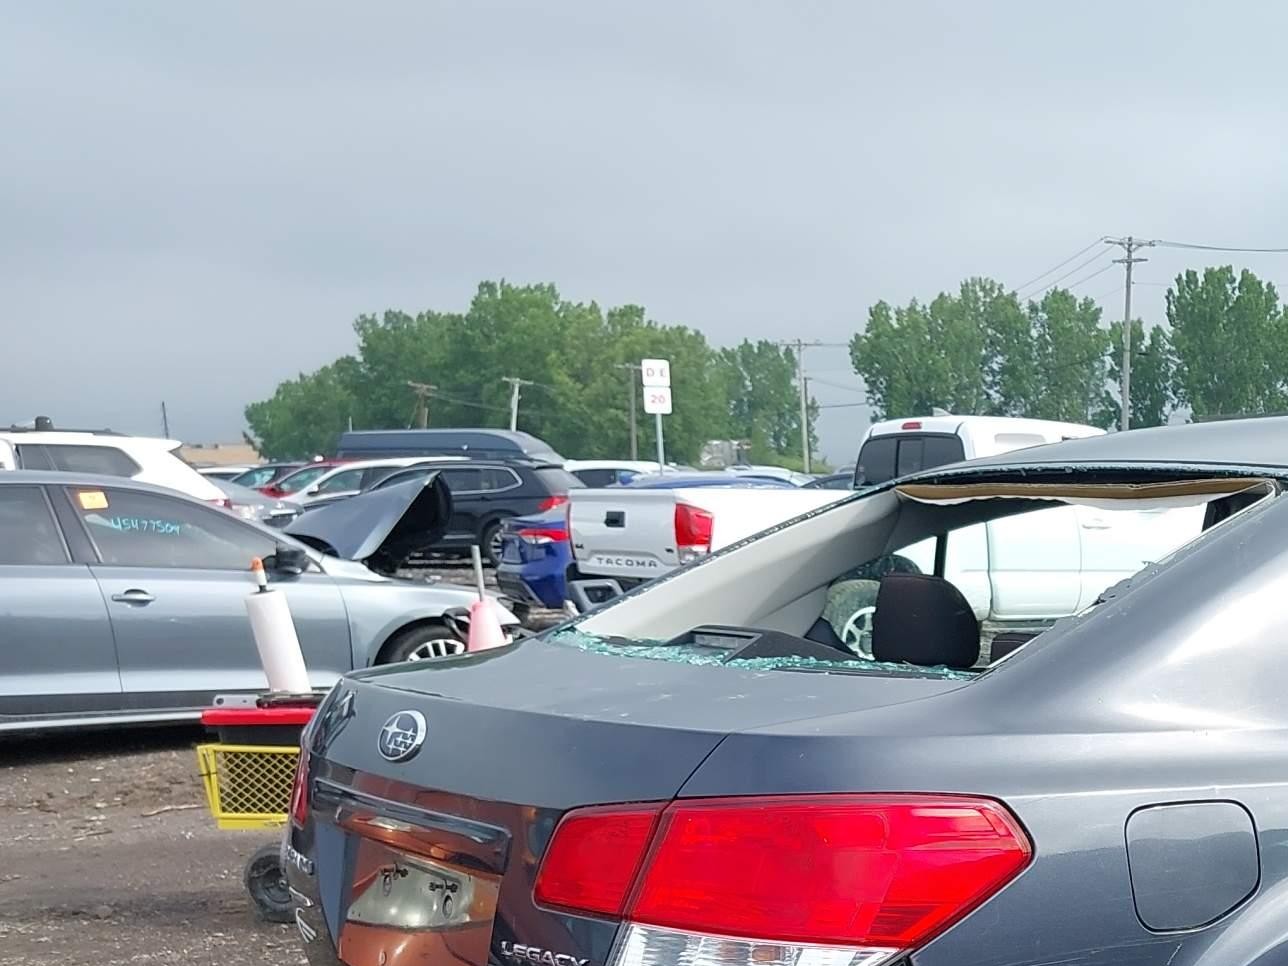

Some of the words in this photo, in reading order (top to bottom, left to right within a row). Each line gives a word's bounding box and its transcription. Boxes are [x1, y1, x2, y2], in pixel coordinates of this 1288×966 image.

[646, 367, 655, 377] D
[650, 394, 665, 404] 20
[596, 557, 658, 568] TACOMA
